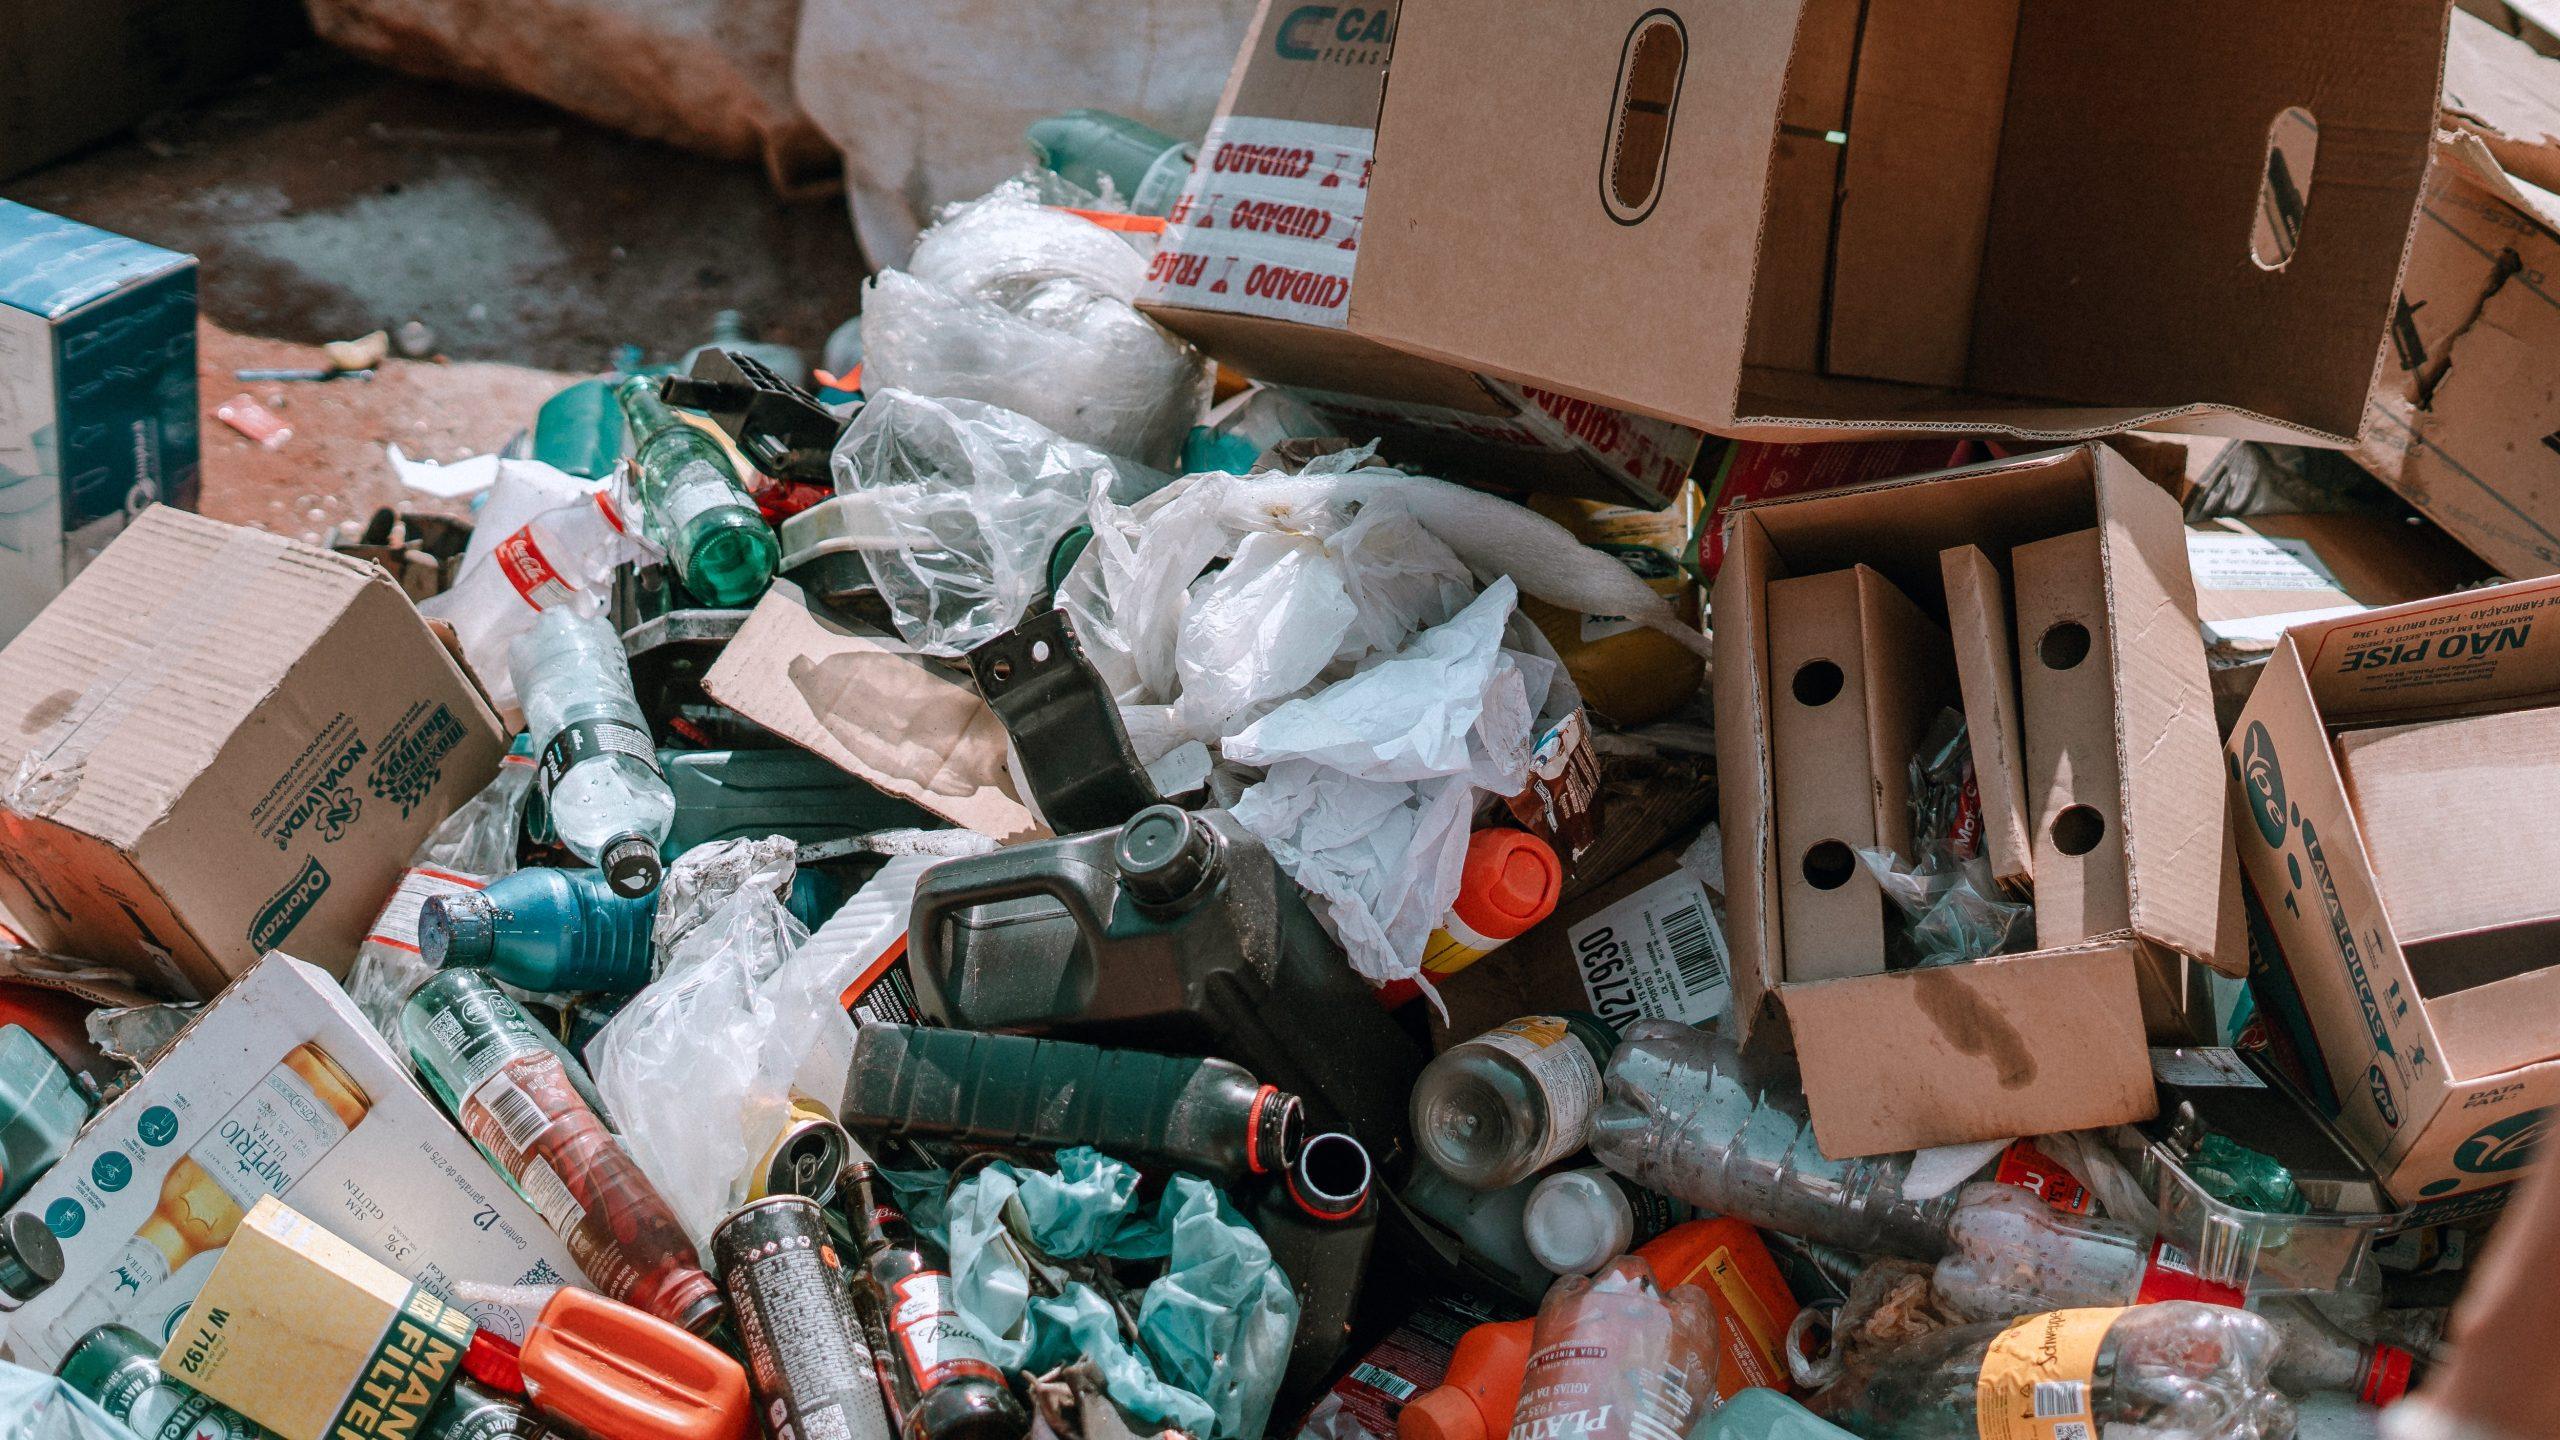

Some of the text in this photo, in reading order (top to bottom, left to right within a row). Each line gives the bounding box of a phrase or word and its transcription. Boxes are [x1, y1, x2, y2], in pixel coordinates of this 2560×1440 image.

[1336, 8, 1392, 43] CA
[1212, 139, 1314, 182] CUIDADO
[1229, 198, 1332, 241] CUIDADO
[1244, 262, 1348, 310] CUIDADO
[2383, 619, 2426, 633] BRUTO:
[2429, 613, 2461, 626] PESO
[2469, 599, 2544, 619] FABRICAÇÃO
[2476, 615, 2534, 630] MANTENHA
[2346, 638, 2383, 651] FRESCO
[2394, 632, 2419, 643] SECO
[2421, 626, 2456, 638] LOCAL
[2458, 624, 2472, 632] EM
[2337, 622, 2530, 672] NÃO PISE
[316, 738, 368, 794] NOVA
[274, 791, 323, 843] VIDA
[252, 870, 327, 949] Odorizan
[1577, 926, 1641, 1030] V27930
[882, 977, 909, 1023] ANTIFERVURA
[216, 1116, 292, 1194] IMPERIO
[247, 1121, 290, 1161] ULTRA
[342, 1196, 369, 1222] SEM
[418, 1139, 529, 1250] Contém 12 garrafas de 275 ml
[380, 1231, 412, 1262] 3%
[121, 1252, 154, 1284] ULTRA
[414, 1268, 449, 1302] LIGHT
[424, 1260, 447, 1283] Kcal
[177, 1304, 230, 1376] W 7192
[117, 1377, 145, 1407] MALT
[375, 1335, 457, 1440] MAN
[486, 1418, 515, 1432] PURE
